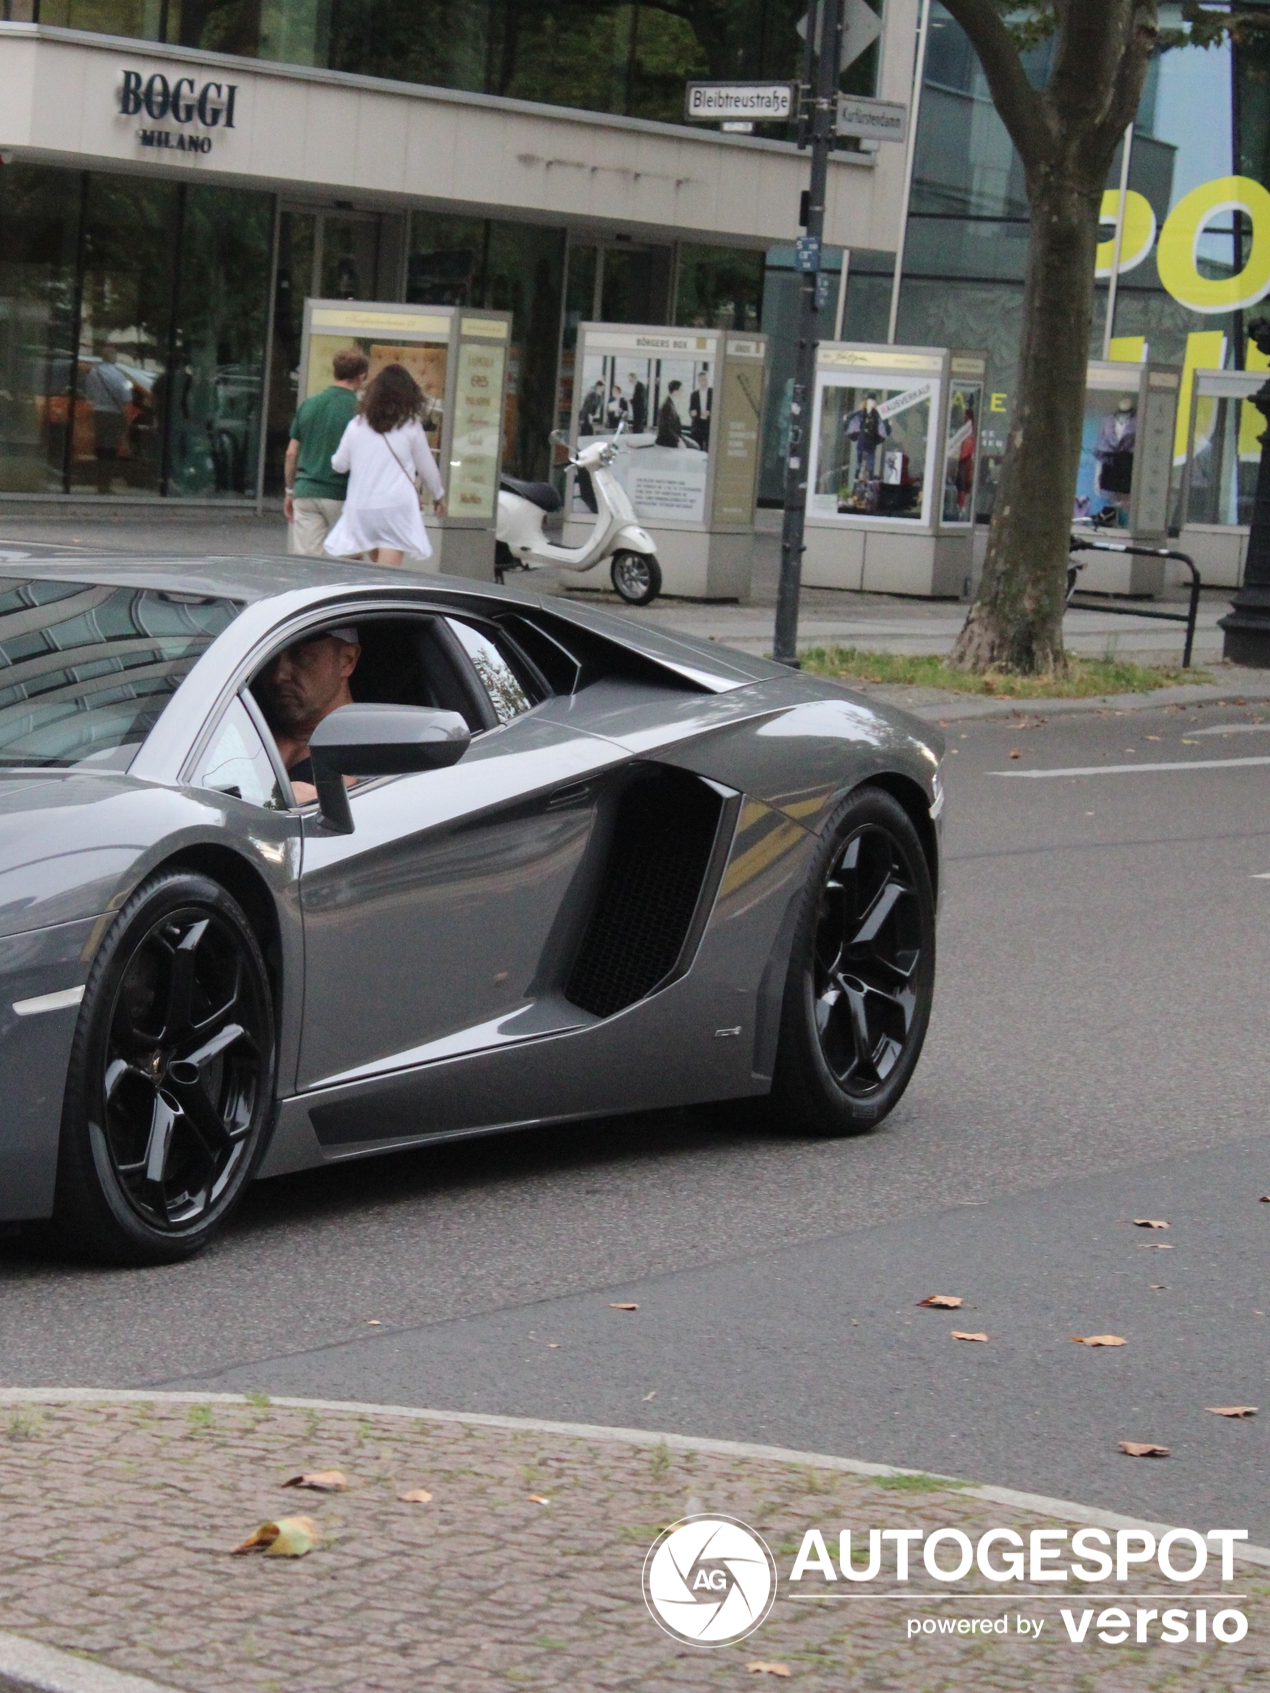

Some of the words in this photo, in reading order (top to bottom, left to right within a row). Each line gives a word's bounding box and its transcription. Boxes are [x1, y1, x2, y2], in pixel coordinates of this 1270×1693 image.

[119, 70, 239, 128] BOGGI
[693, 90, 788, 111] Bleibtreustraße
[141, 128, 212, 154] MILANO
